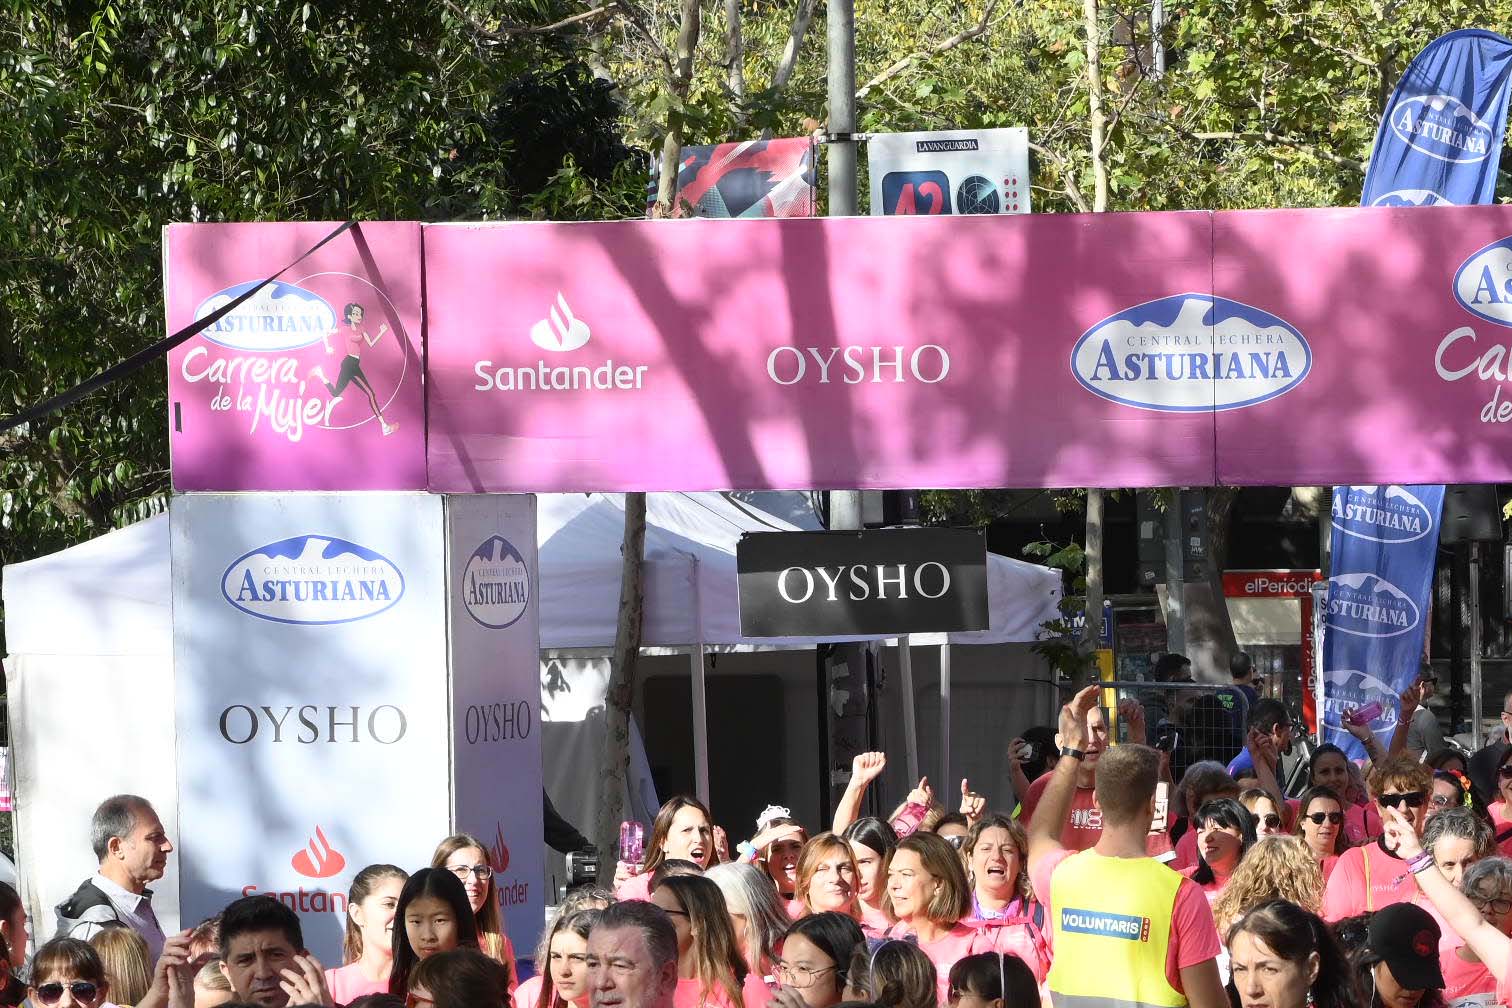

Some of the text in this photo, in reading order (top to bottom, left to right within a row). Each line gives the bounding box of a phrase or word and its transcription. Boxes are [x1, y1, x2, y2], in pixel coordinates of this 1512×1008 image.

[1397, 107, 1487, 155] ASTURIANA
[1126, 333, 1285, 347] CENTRAL LECHERA
[181, 346, 300, 384] Carrera
[473, 359, 649, 392] Santander
[766, 344, 951, 387] OYSHO
[1089, 338, 1294, 381] ASTURIANA
[210, 380, 344, 443] de la Mujer
[1331, 493, 1422, 534] ASTURIANA
[235, 568, 392, 603] ASTURIANA
[263, 565, 322, 576] CENTRAL
[776, 561, 952, 605] OYSHO
[1244, 577, 1313, 594] elPeriódi
[467, 575, 526, 607] ASTURIANA
[1326, 598, 1409, 628] STURIANA
[218, 704, 408, 745] OYSHO
[465, 699, 532, 746] OYSHO
[1062, 912, 1139, 935] VOLUNTARIS
